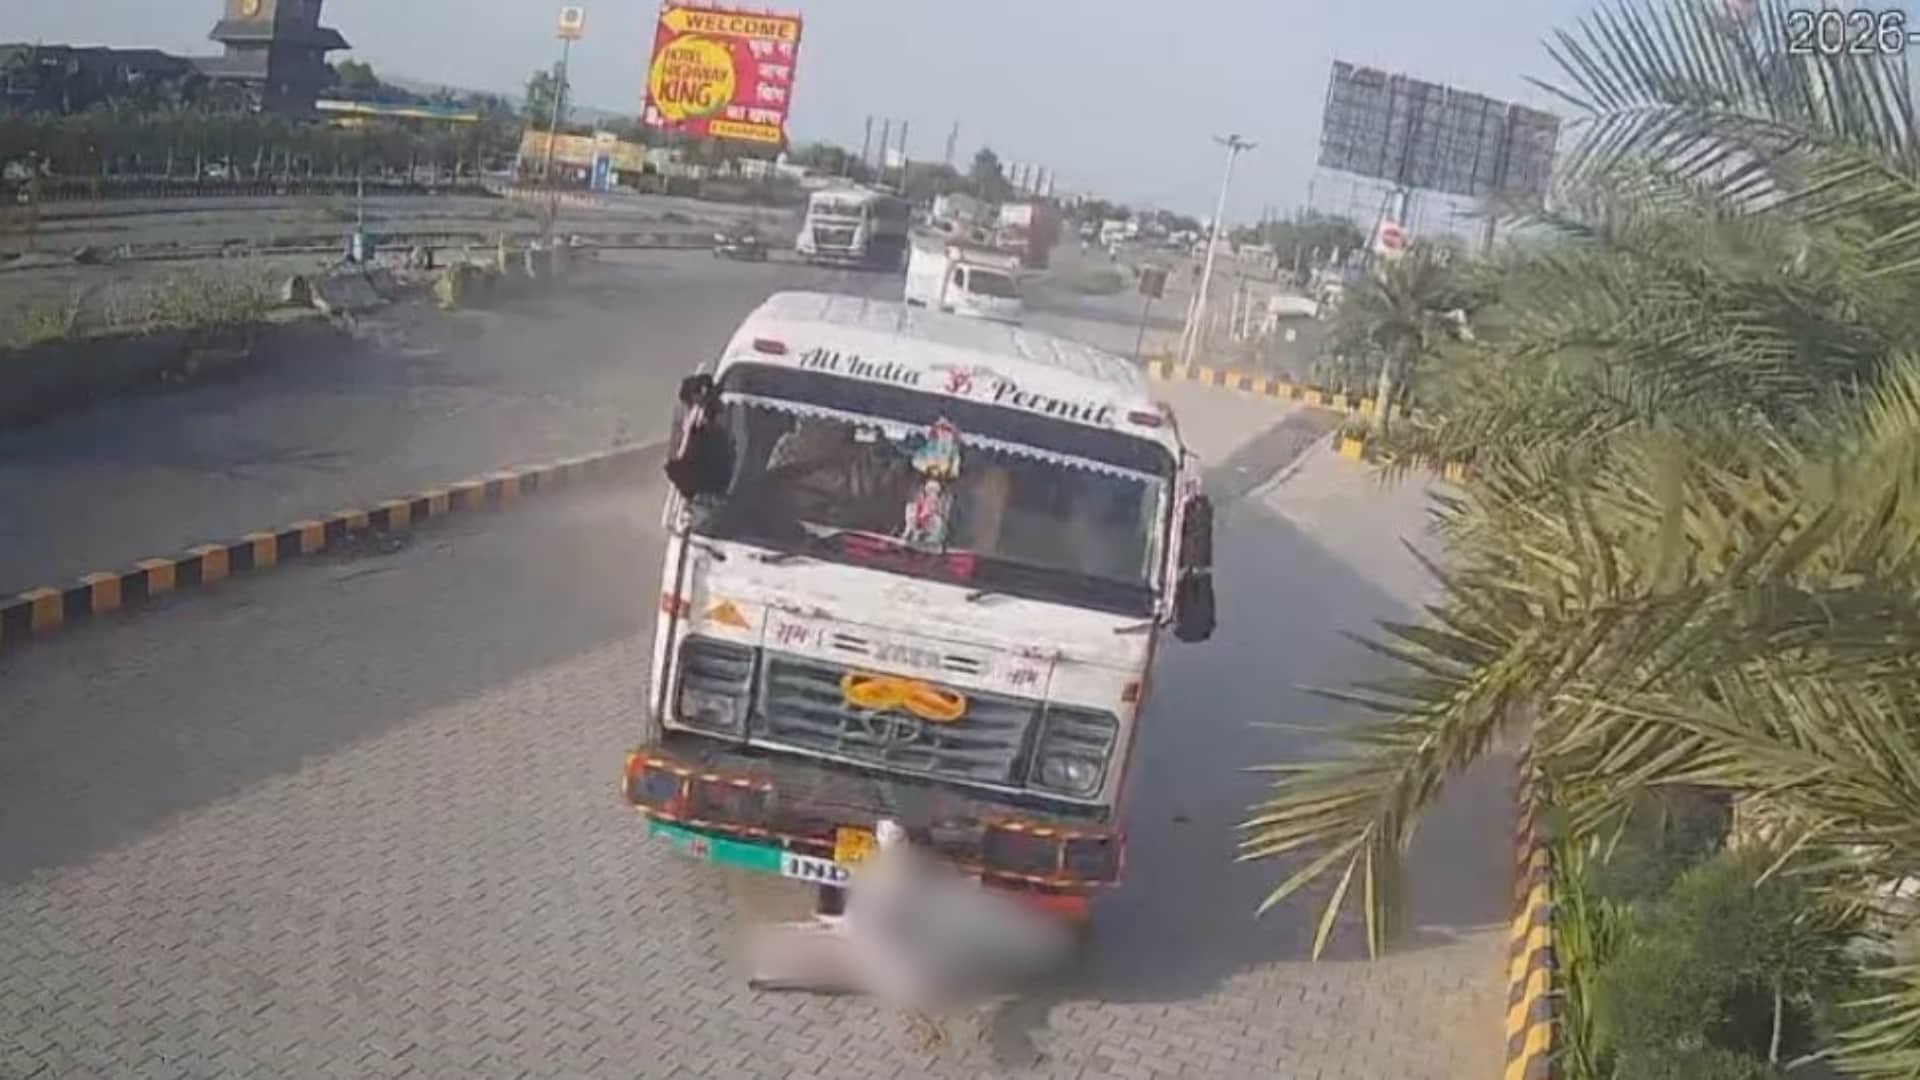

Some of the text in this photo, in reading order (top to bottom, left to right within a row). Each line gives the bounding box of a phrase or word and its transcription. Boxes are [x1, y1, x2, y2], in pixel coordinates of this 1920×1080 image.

[686, 14, 791, 38] WELCOME
[659, 79, 712, 107] KING
[847, 354, 921, 386] India
[990, 379, 1116, 427] Permit
